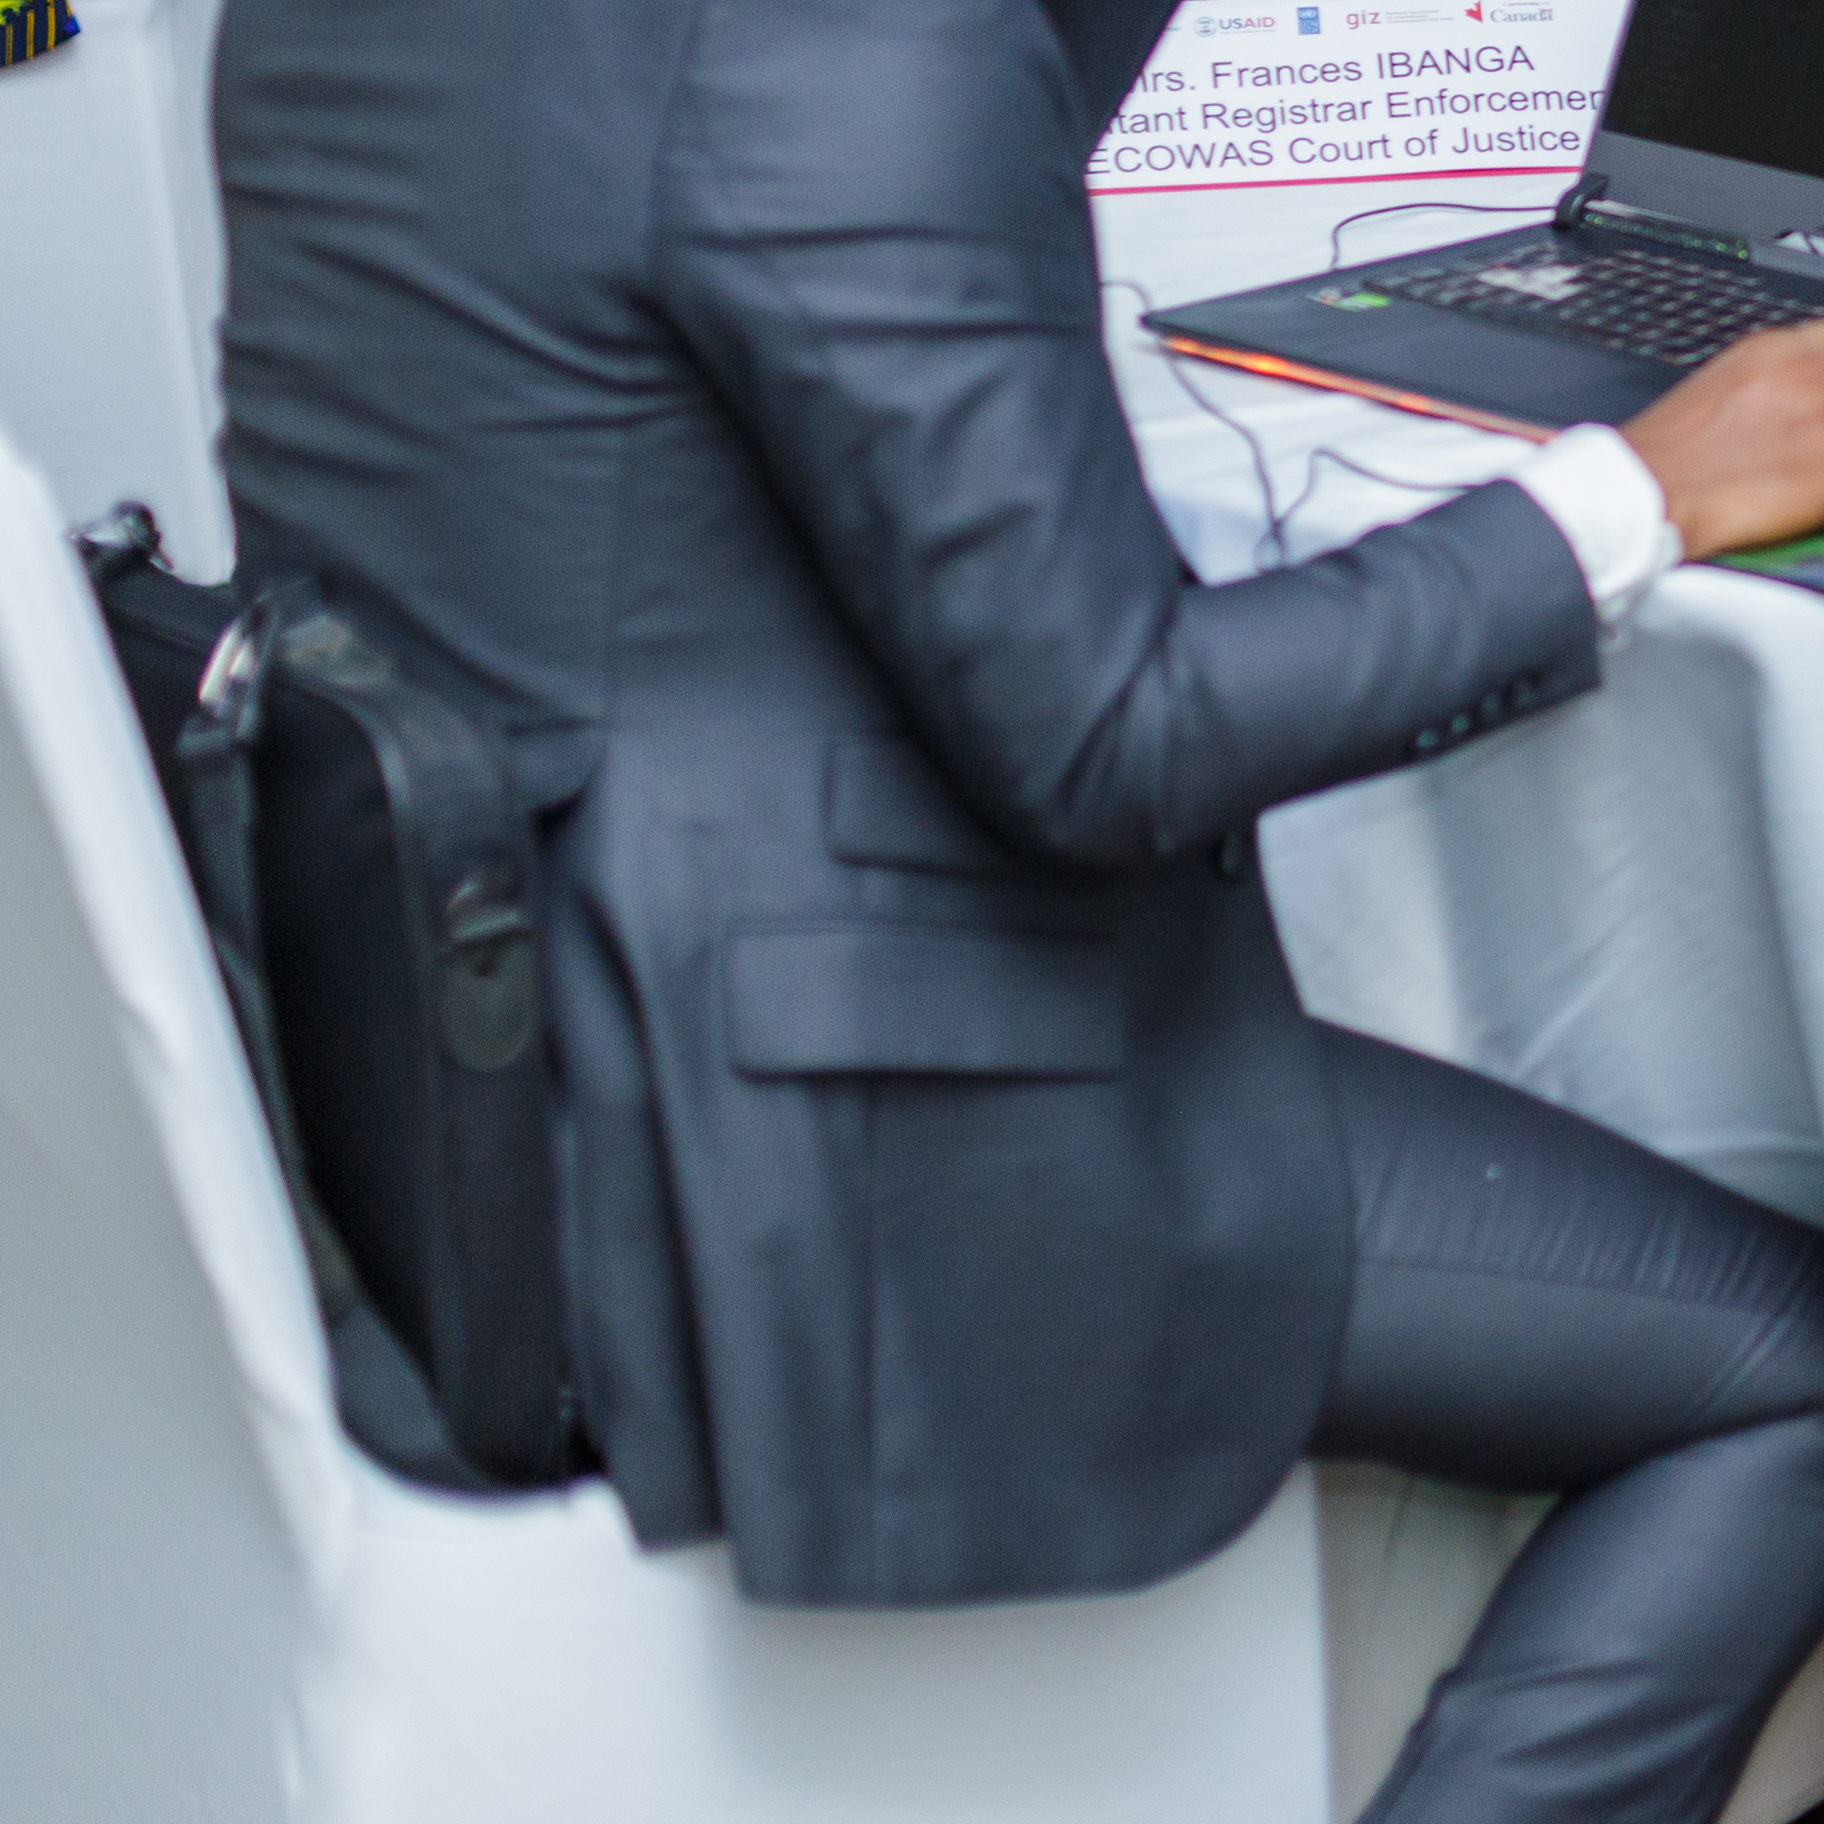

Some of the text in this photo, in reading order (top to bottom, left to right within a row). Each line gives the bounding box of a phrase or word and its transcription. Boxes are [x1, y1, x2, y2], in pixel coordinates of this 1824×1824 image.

[1218, 16, 1276, 31] USAID
[1346, 9, 1381, 30] giz
[1490, 7, 1554, 23] Canada
[1211, 60, 1363, 90] Frances
[1377, 45, 1535, 80] IBANGA
[1109, 87, 1605, 135] tant Registrar Enforcemen
[1087, 124, 1580, 175] ECOWAS Court of Justice
